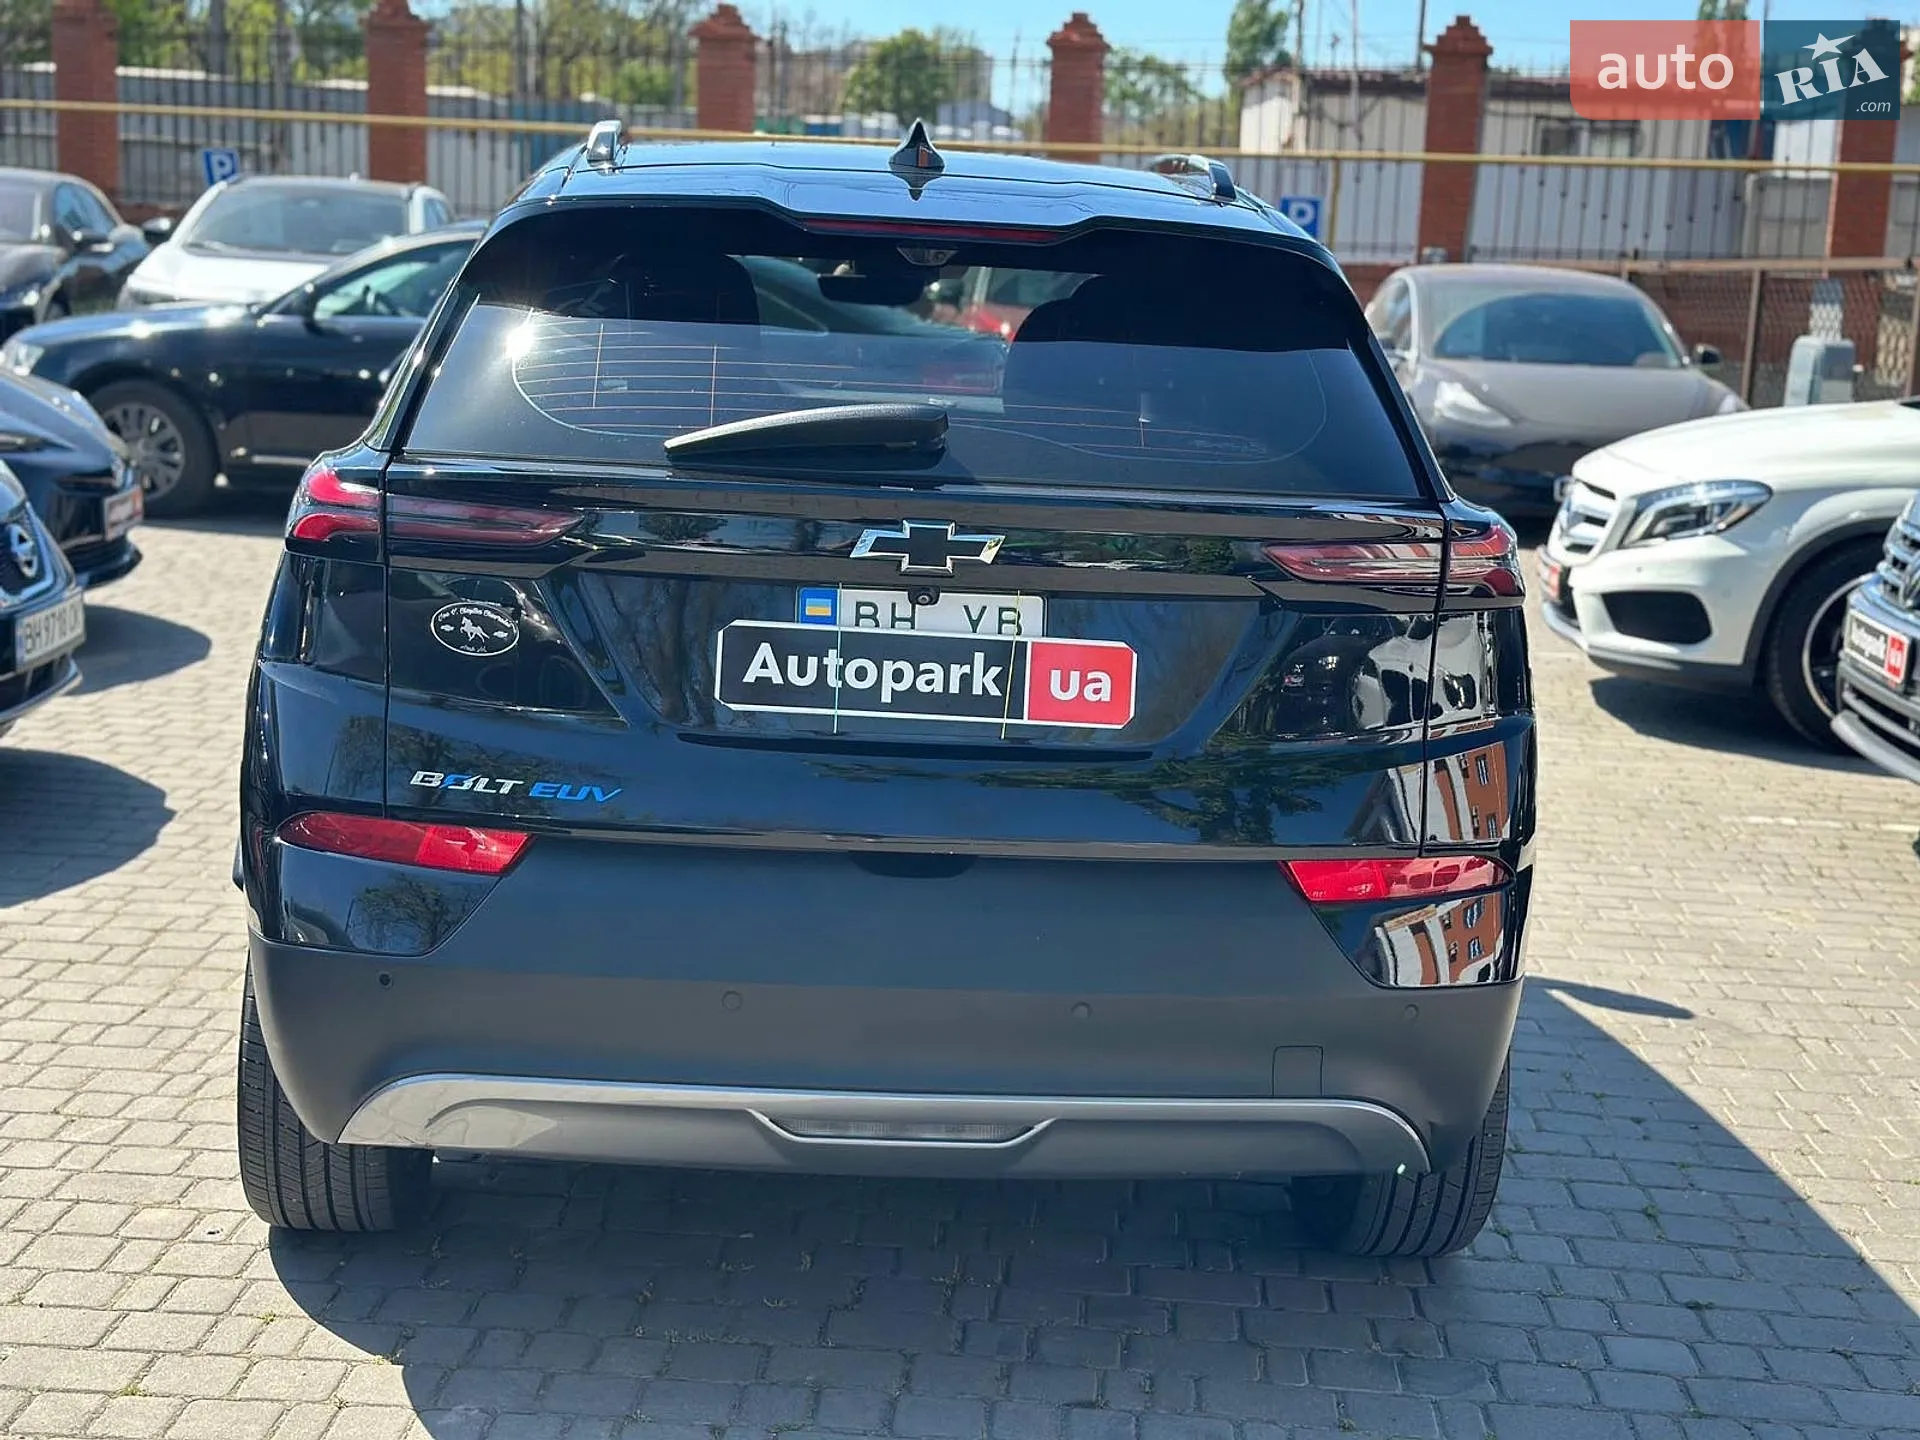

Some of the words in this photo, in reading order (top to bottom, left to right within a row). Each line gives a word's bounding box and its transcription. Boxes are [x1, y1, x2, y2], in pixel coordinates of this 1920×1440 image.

[211, 154, 233, 183] P
[854, 601, 917, 631] BH
[743, 642, 1003, 704] Autopark
[1049, 668, 1113, 702] ua
[409, 770, 525, 795] BOLT
[528, 781, 623, 802] EUV
